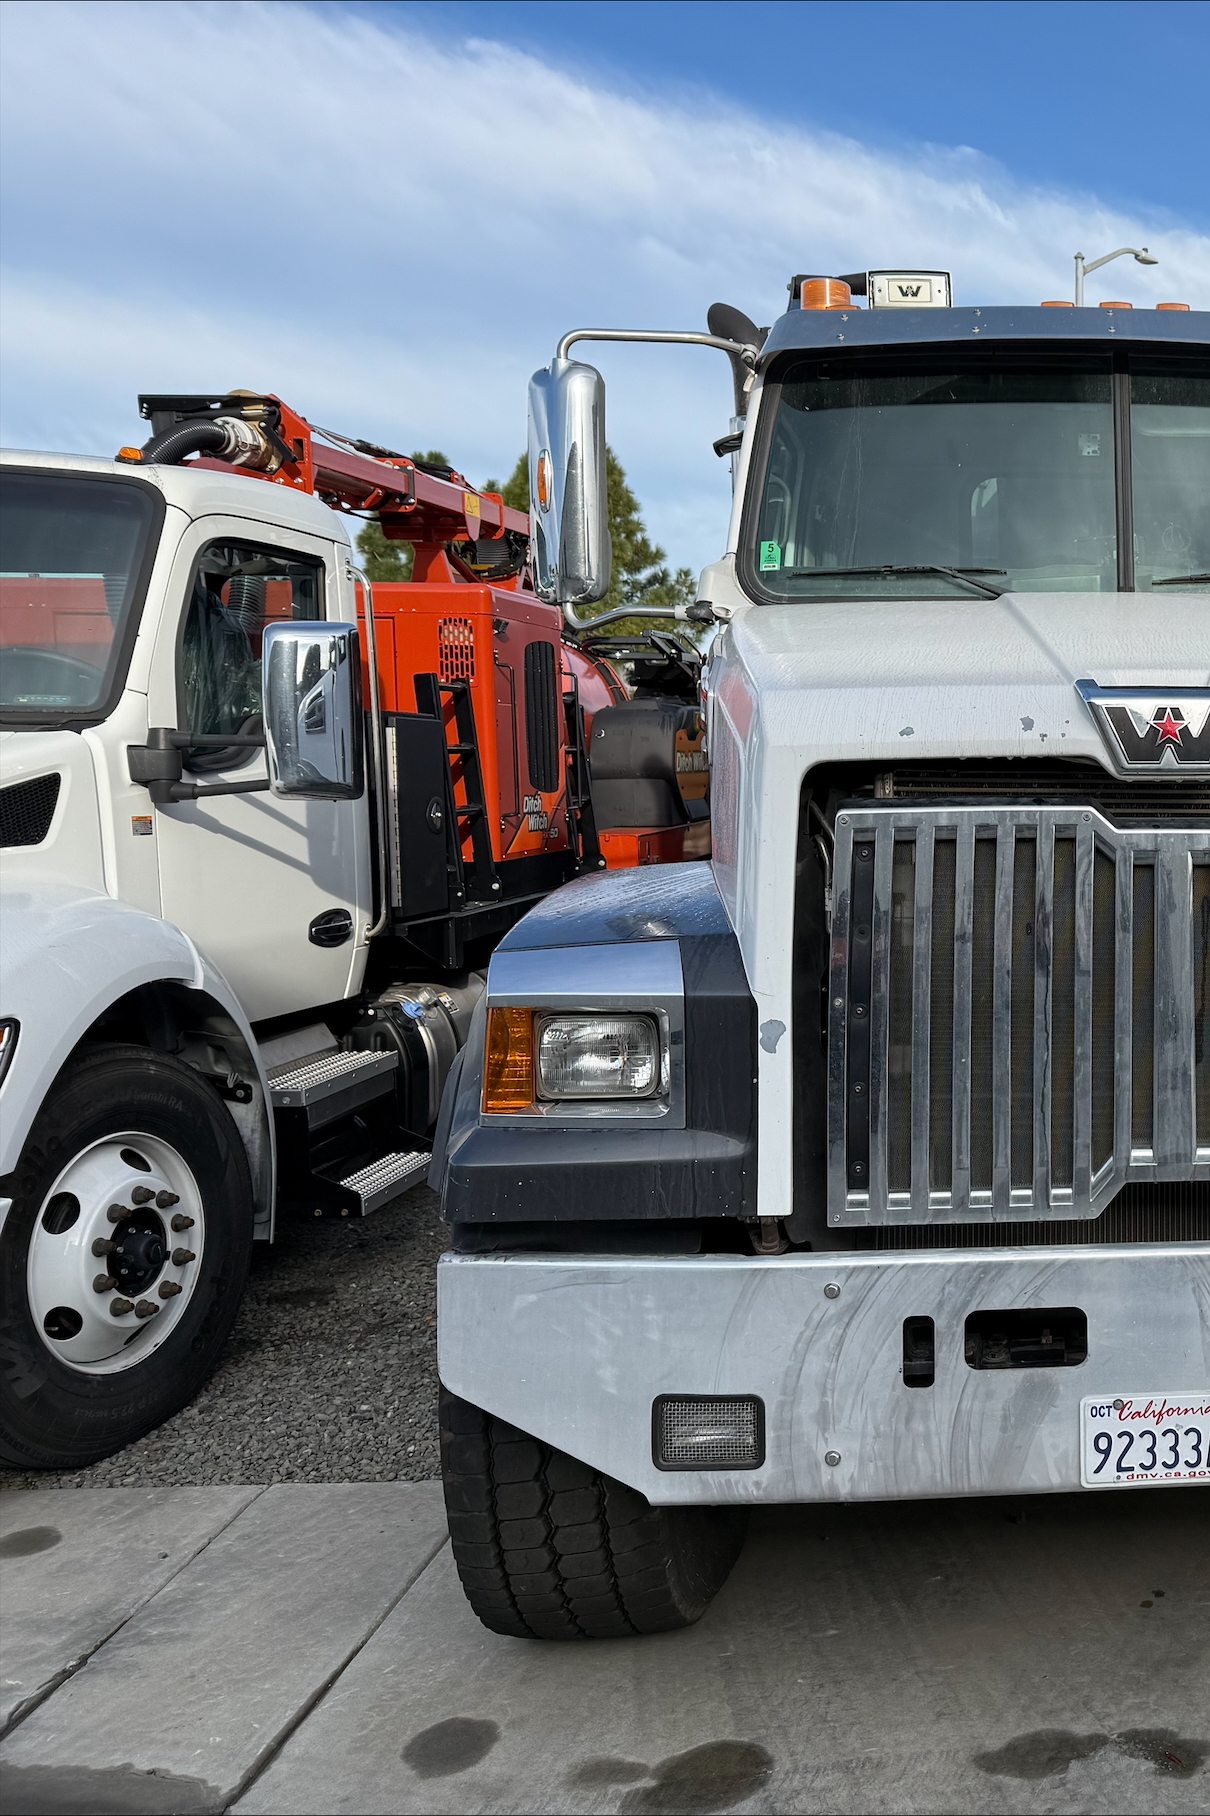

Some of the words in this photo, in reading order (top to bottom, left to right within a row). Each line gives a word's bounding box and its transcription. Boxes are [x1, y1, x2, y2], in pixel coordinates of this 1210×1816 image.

[767, 543, 774, 553] 5
[523, 794, 542, 813] Ditch
[528, 811, 548, 831] Witch
[1090, 1405, 1113, 1418] OCT
